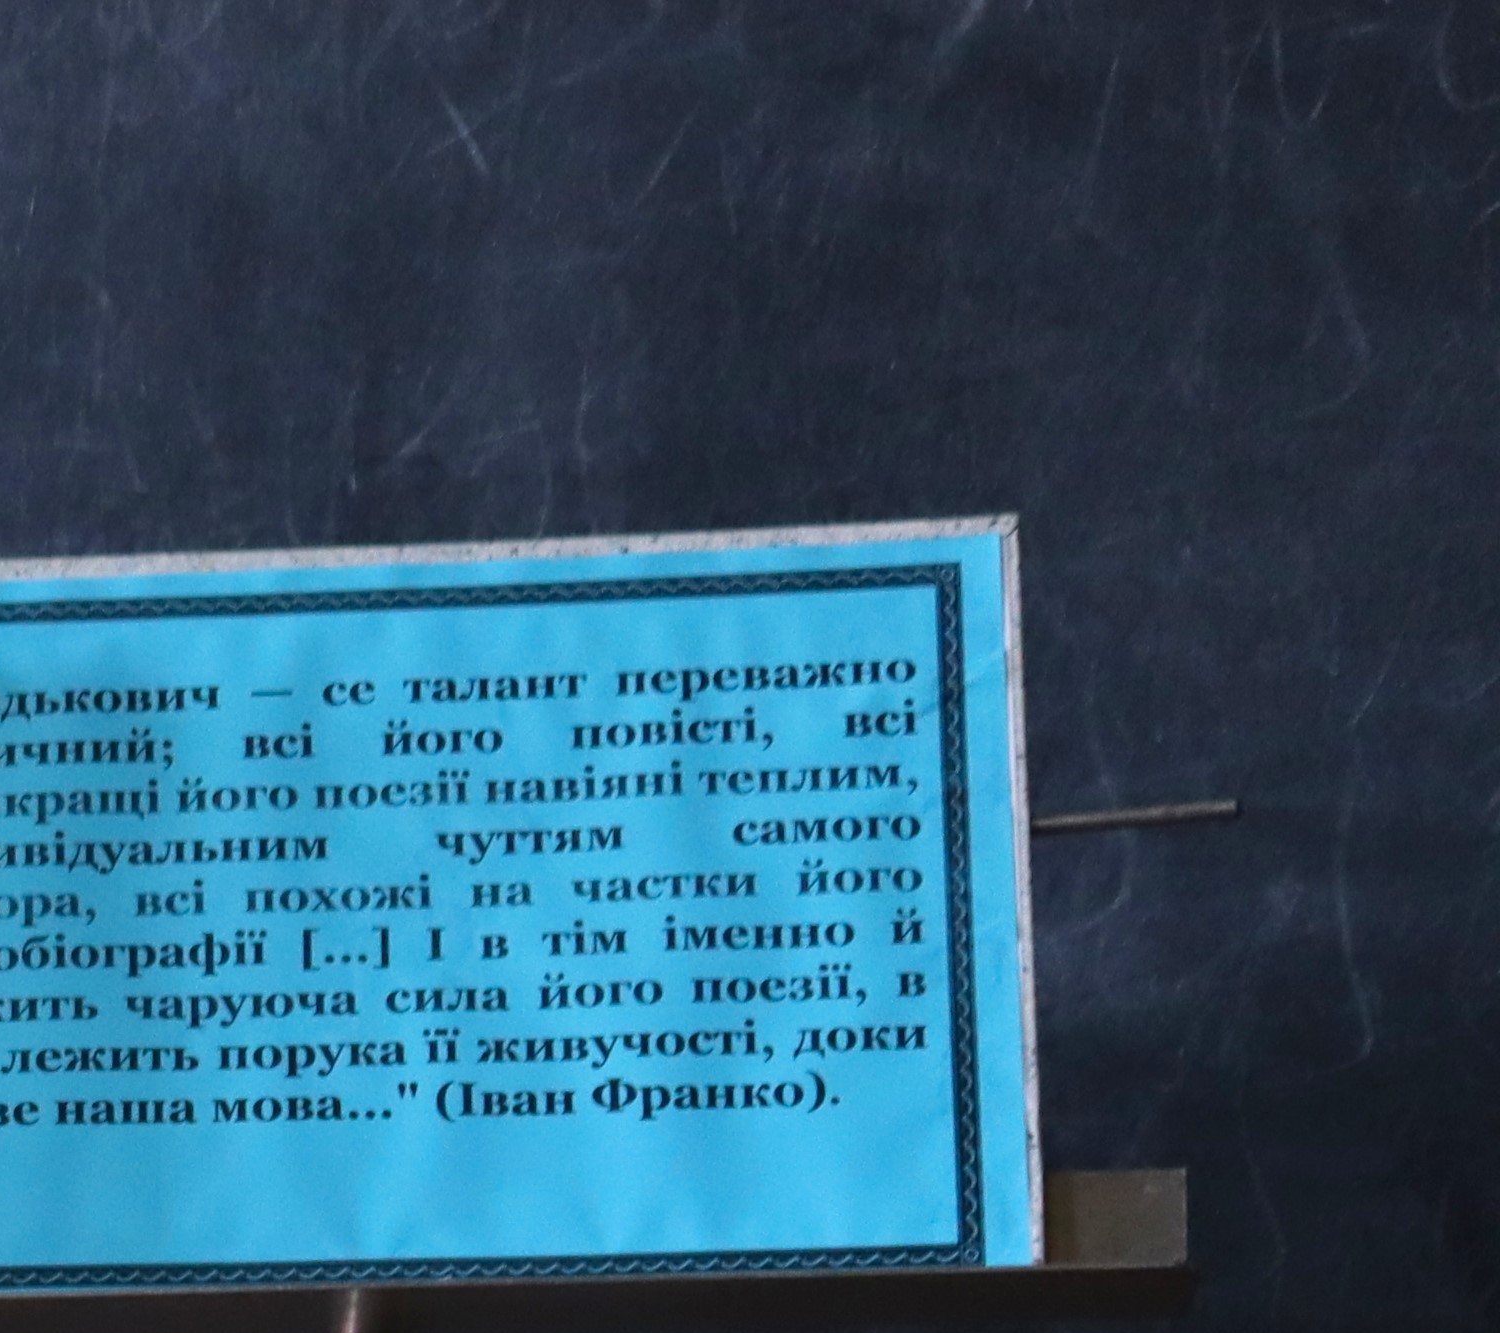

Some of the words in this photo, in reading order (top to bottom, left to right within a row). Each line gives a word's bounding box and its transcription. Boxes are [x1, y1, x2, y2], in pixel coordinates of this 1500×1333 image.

[322, 679, 375, 707] се
[403, 670, 587, 703] талант
[616, 657, 917, 702] переважно
[244, 722, 315, 760] всі
[383, 719, 503, 756] його
[572, 706, 774, 751] повісті,
[844, 698, 917, 738] всі
[178, 776, 299, 814] його
[315, 769, 470, 809] поезії
[486, 760, 683, 804] навіяні
[698, 762, 919, 796] теплим,
[436, 825, 624, 865] чуттям
[732, 814, 921, 846] самого
[135, 879, 207, 917] всі
[245, 873, 431, 914] похожі
[471, 880, 532, 908] на
[573, 870, 758, 902] частки
[799, 859, 923, 895] його
[427, 927, 443, 961] І
[481, 933, 509, 959] в
[542, 919, 628, 956] тім
[664, 915, 855, 952] іменно
[892, 908, 924, 945] й
[126, 989, 358, 1029] чаруюча
[385, 983, 510, 1013] сила
[539, 973, 663, 1010] його
[692, 963, 868, 1006] поезії,
[899, 971, 927, 998] в
[1, 1044, 199, 1074] лежить
[218, 1039, 407, 1078] порука
[423, 1028, 460, 1063] її
[477, 1018, 774, 1069] живучості,
[793, 1023, 927, 1059] доки
[55, 1095, 196, 1126] наша
[212, 1081, 418, 1124] мова..."
[436, 1079, 575, 1123] (Іван
[591, 1070, 841, 1122] Франко).
